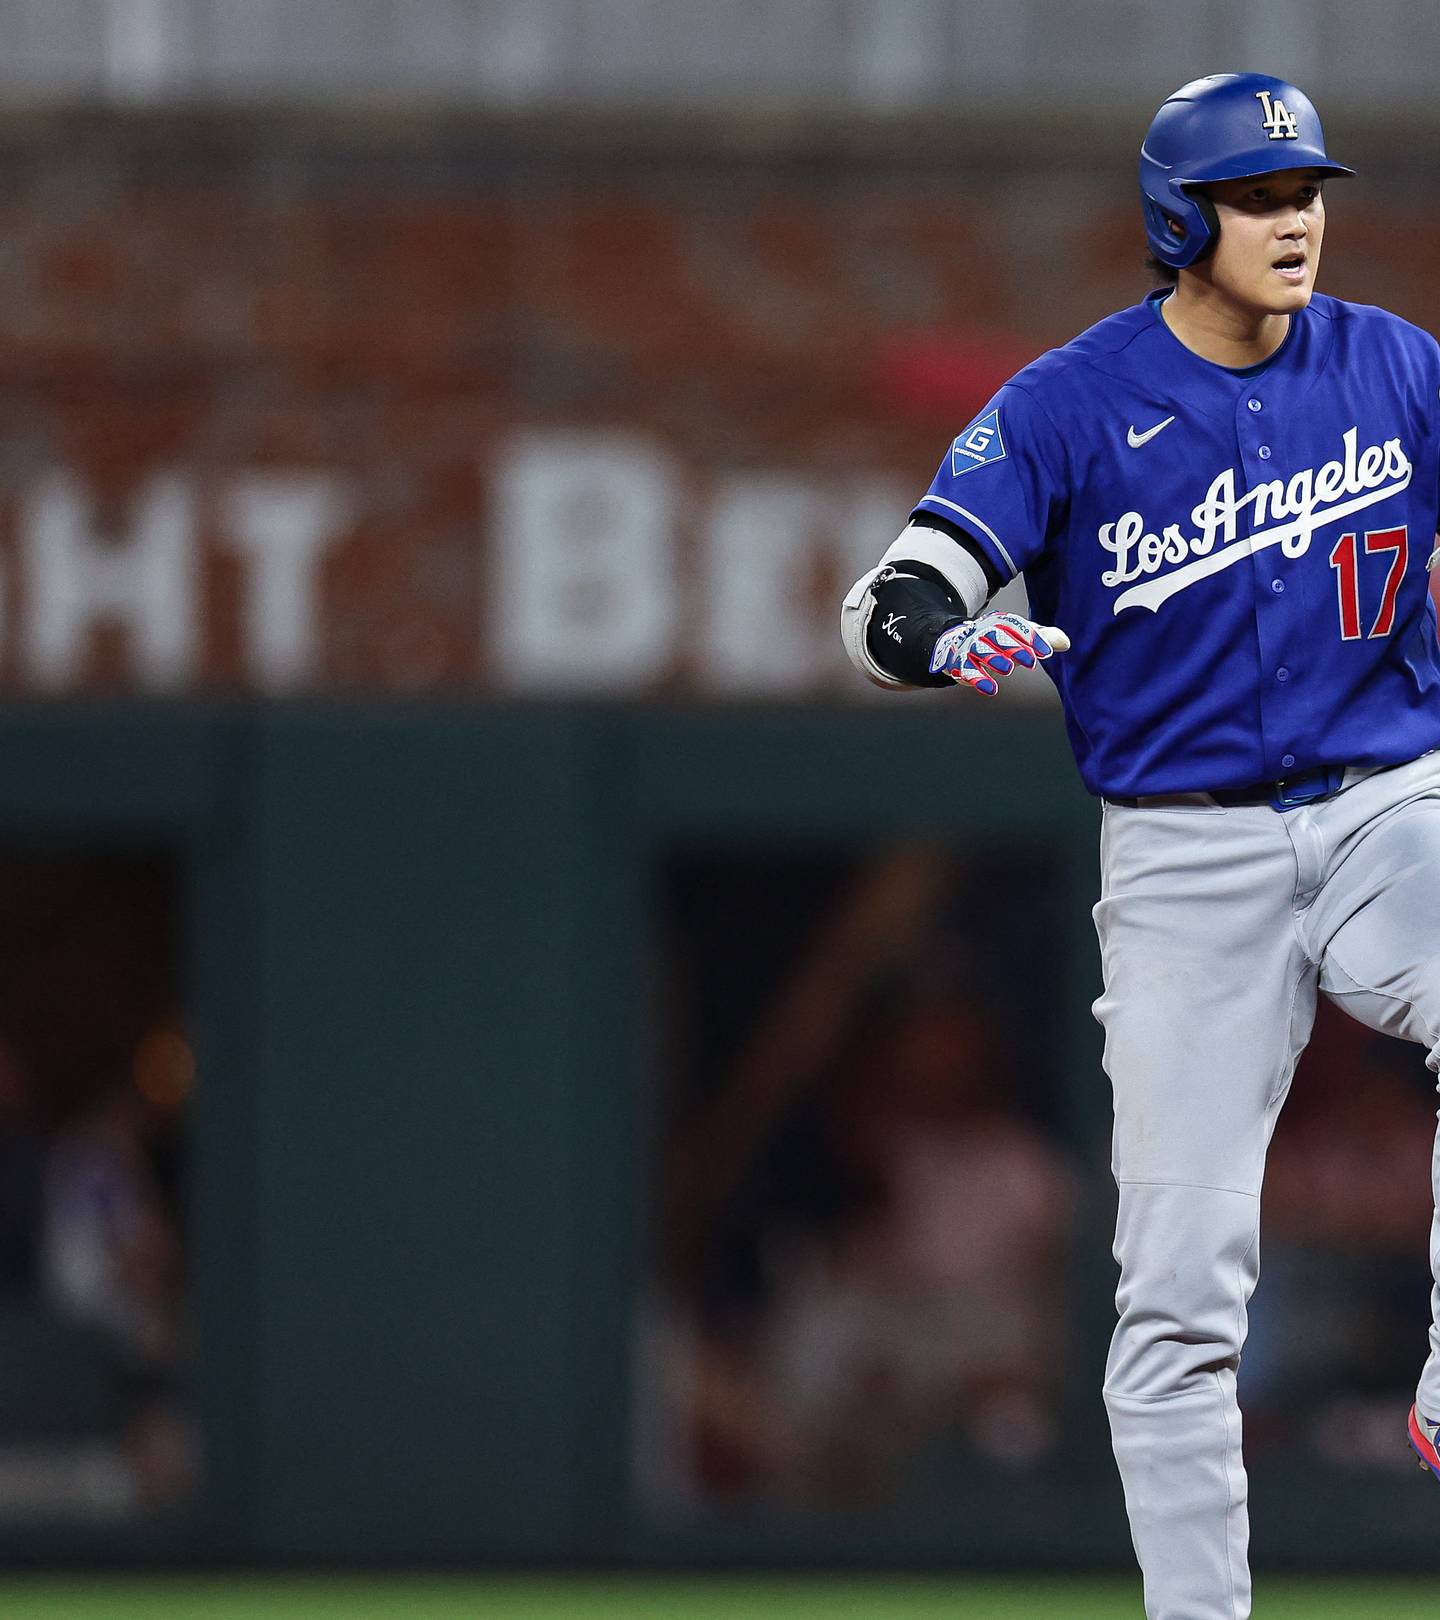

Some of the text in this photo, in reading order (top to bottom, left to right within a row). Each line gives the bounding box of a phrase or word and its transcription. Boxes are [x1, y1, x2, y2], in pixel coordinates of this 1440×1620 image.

[1256, 90, 1299, 139] LA
[964, 426, 995, 452] G
[1098, 425, 1414, 588] Los Angeles
[1329, 524, 1409, 641] 17
